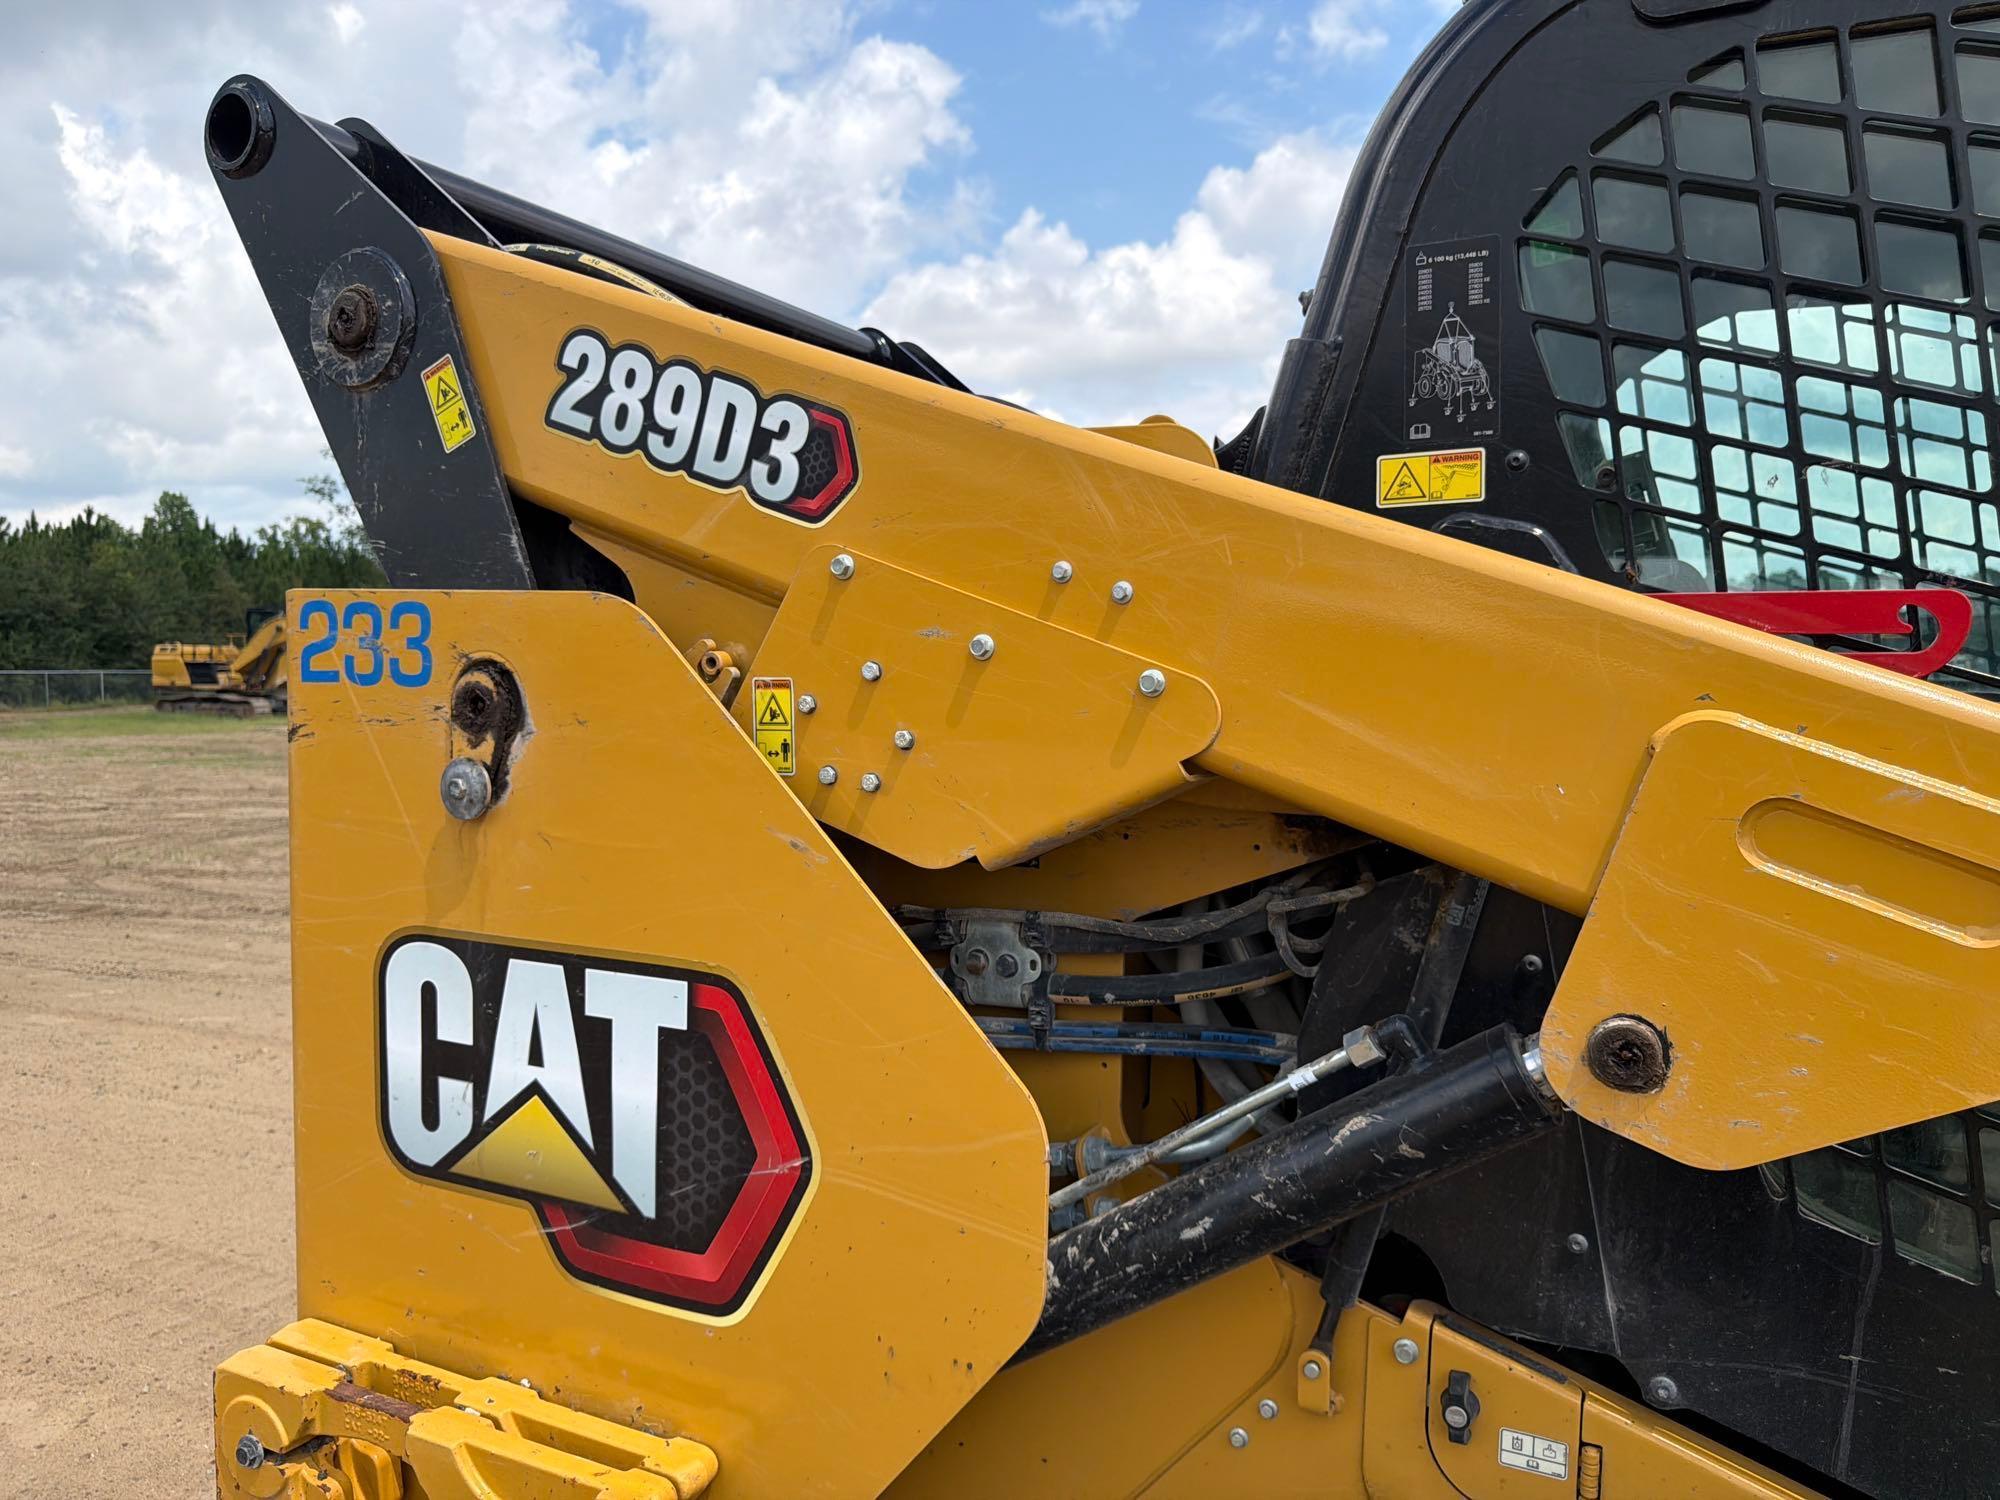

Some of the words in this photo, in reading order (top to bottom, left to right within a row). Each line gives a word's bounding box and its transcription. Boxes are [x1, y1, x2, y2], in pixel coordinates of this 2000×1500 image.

[548, 333, 811, 503] 289D3
[1441, 453, 1479, 463] WARNING
[299, 599, 433, 687] 233
[384, 940, 688, 1220] CAT
